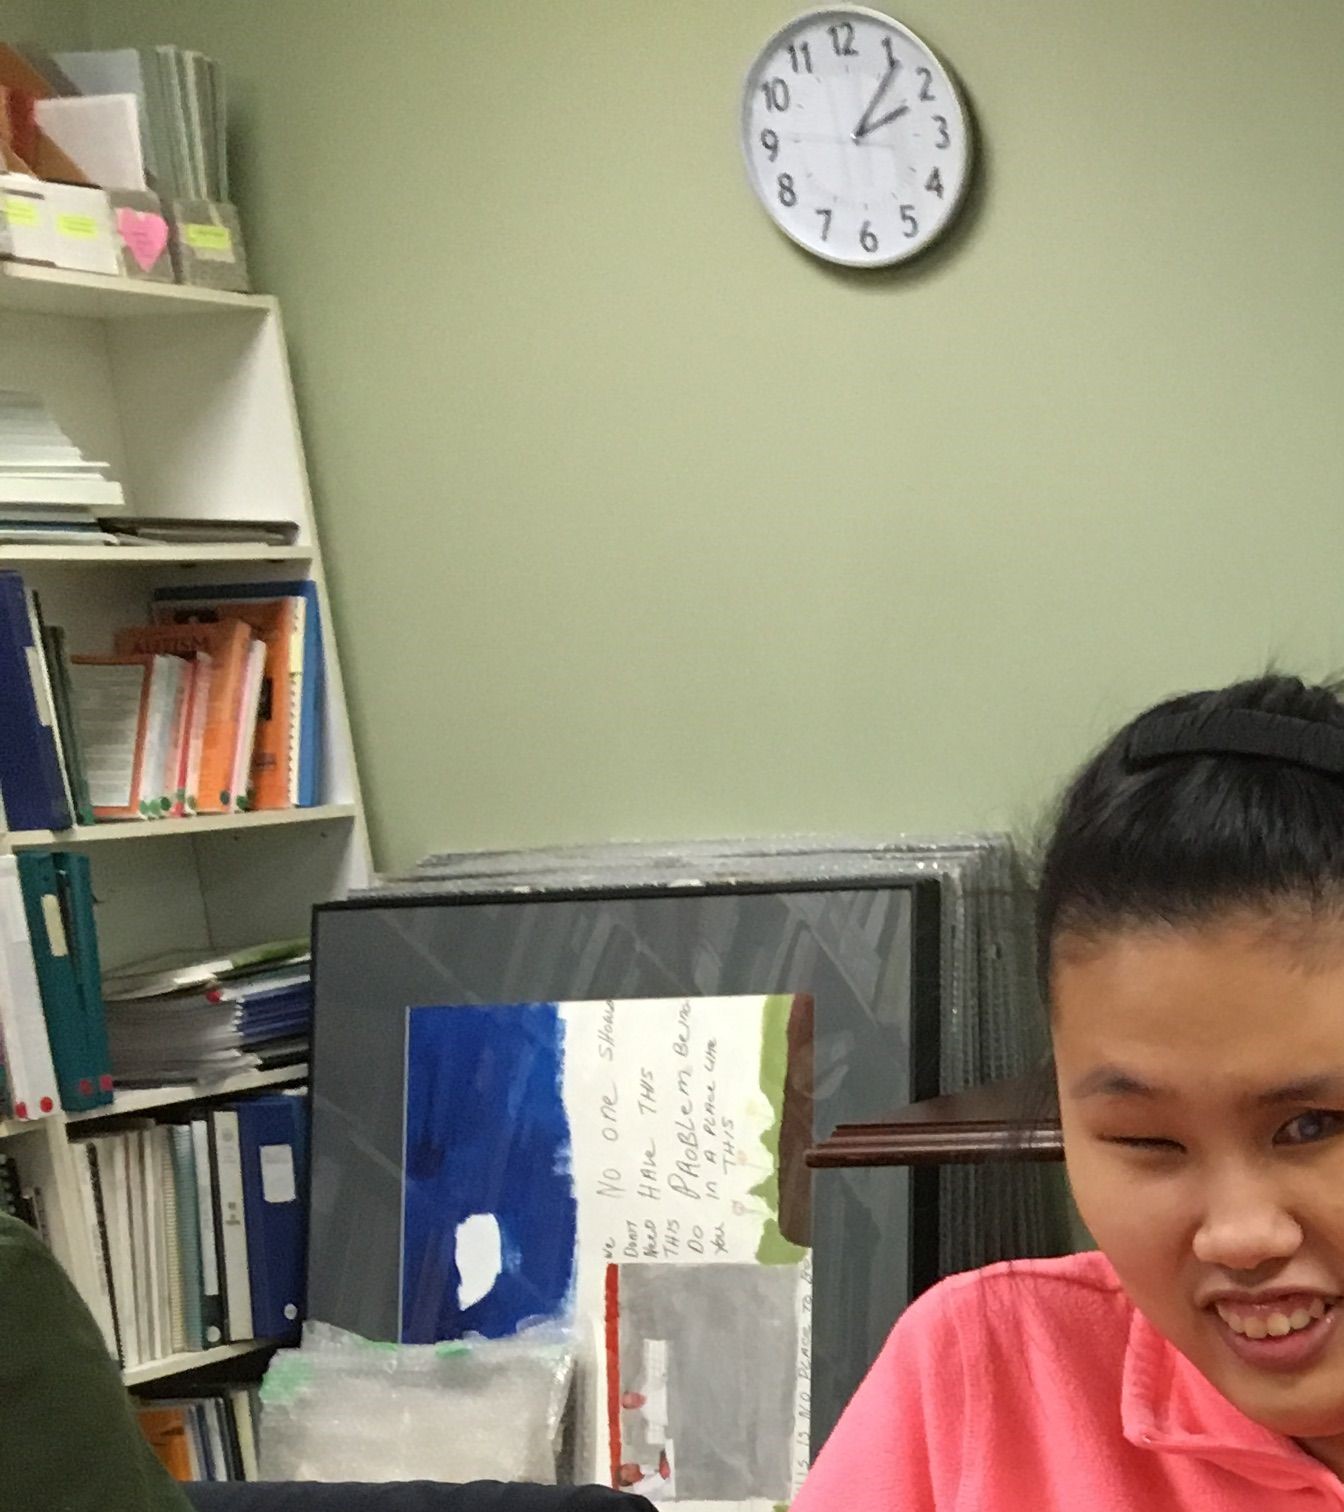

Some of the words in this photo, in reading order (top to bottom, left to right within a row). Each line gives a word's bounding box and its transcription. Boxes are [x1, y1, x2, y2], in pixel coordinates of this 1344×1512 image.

[827, 22, 858, 56] 12
[882, 37, 895, 68] 1
[788, 42, 812, 73] 11
[761, 77, 790, 112] 10
[915, 67, 935, 101] 2
[761, 129, 779, 162] 9
[931, 115, 950, 149] 3
[777, 172, 797, 207] 8
[925, 167, 944, 199] 4
[816, 209, 832, 241] 7
[859, 220, 878, 252] 6
[900, 204, 918, 238] 5
